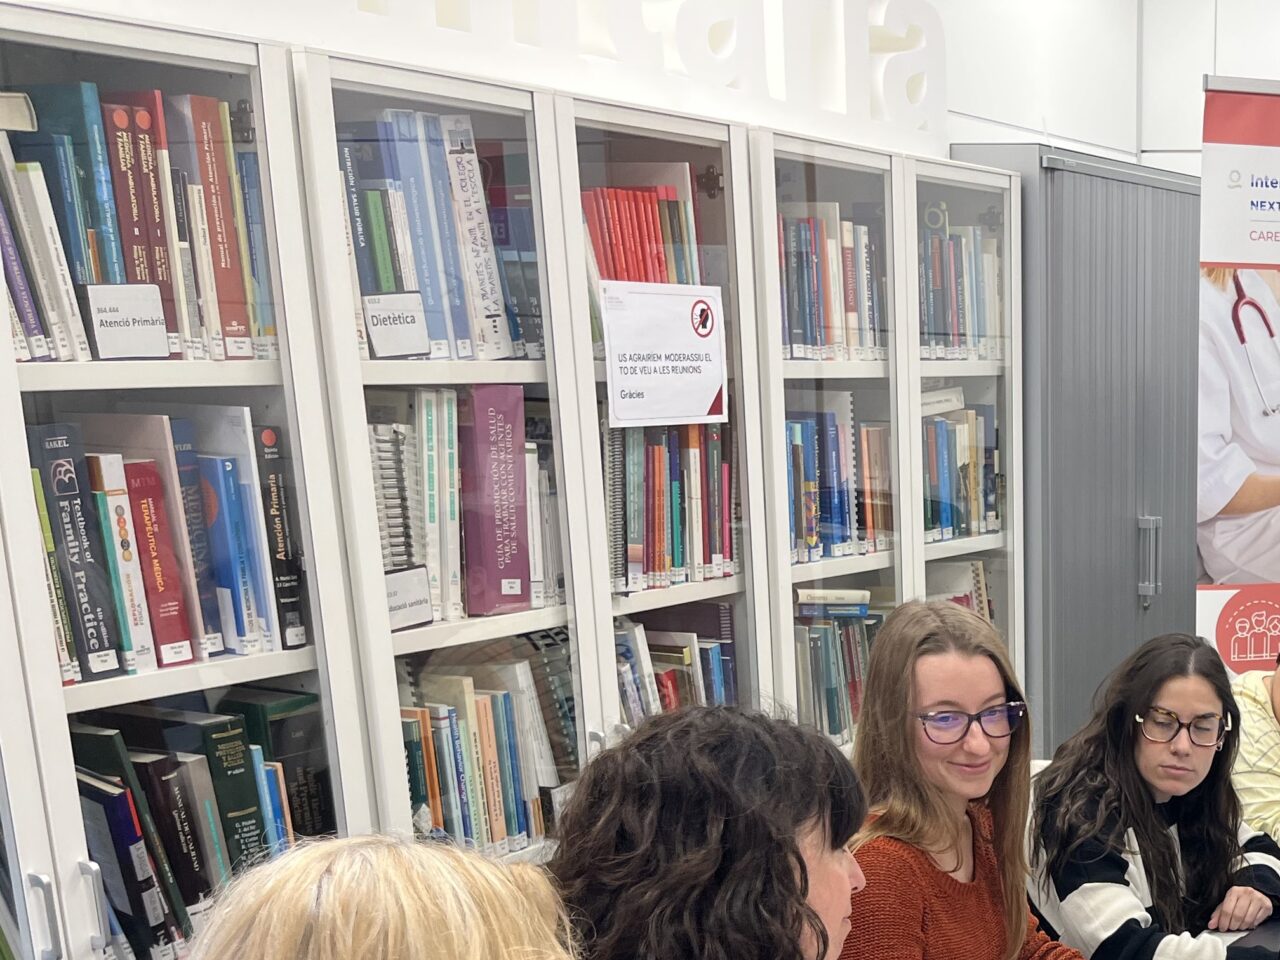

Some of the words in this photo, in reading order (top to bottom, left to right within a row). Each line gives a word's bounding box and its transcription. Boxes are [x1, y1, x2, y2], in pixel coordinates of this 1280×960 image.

[344, 148, 354, 186] NUTRICIÓN
[126, 171, 139, 222] AMBULATORIA
[149, 171, 160, 223] AMBULATORIA
[351, 193, 360, 214] SALUD
[354, 215, 366, 248] PÚBLICA
[99, 317, 130, 328] Atenció
[132, 317, 165, 327] Primària
[371, 312, 416, 327] Dietètica
[618, 353, 628, 362] US
[664, 353, 704, 362] MODERASSIU
[704, 353, 712, 362] EL
[619, 366, 629, 375] TO
[630, 366, 638, 375] DE
[639, 366, 652, 375] VEU
[653, 366, 658, 374] A
[659, 366, 671, 374] LES
[671, 365, 702, 374] REUNIONS
[620, 389, 645, 400] Gràcies
[489, 407, 498, 442] SALUD
[497, 413, 506, 460] AGENTES
[491, 444, 499, 459] DE
[505, 423, 515, 503] COMUNITARIOS
[499, 463, 508, 487] CON
[269, 474, 281, 516] Primaria
[492, 461, 502, 525] PROMOCIÓN
[501, 488, 510, 535] TRABAJAR
[509, 504, 517, 538] SALUD
[73, 498, 90, 550] Textbook
[85, 550, 94, 563] of
[140, 499, 158, 558] TERAPÉUTICA
[151, 558, 164, 593] MÉDICA
[272, 517, 286, 561] Atención
[496, 527, 503, 541] DE
[496, 543, 505, 569] GUÍA
[503, 539, 511, 563] PARA
[60, 500, 81, 566] Family
[75, 570, 99, 651] Practice
[388, 600, 407, 612] ducació
[96, 607, 104, 620] 4th
[100, 619, 111, 648] edition
[174, 786, 188, 822] MANUAL
[187, 835, 200, 873] CALIDAD
